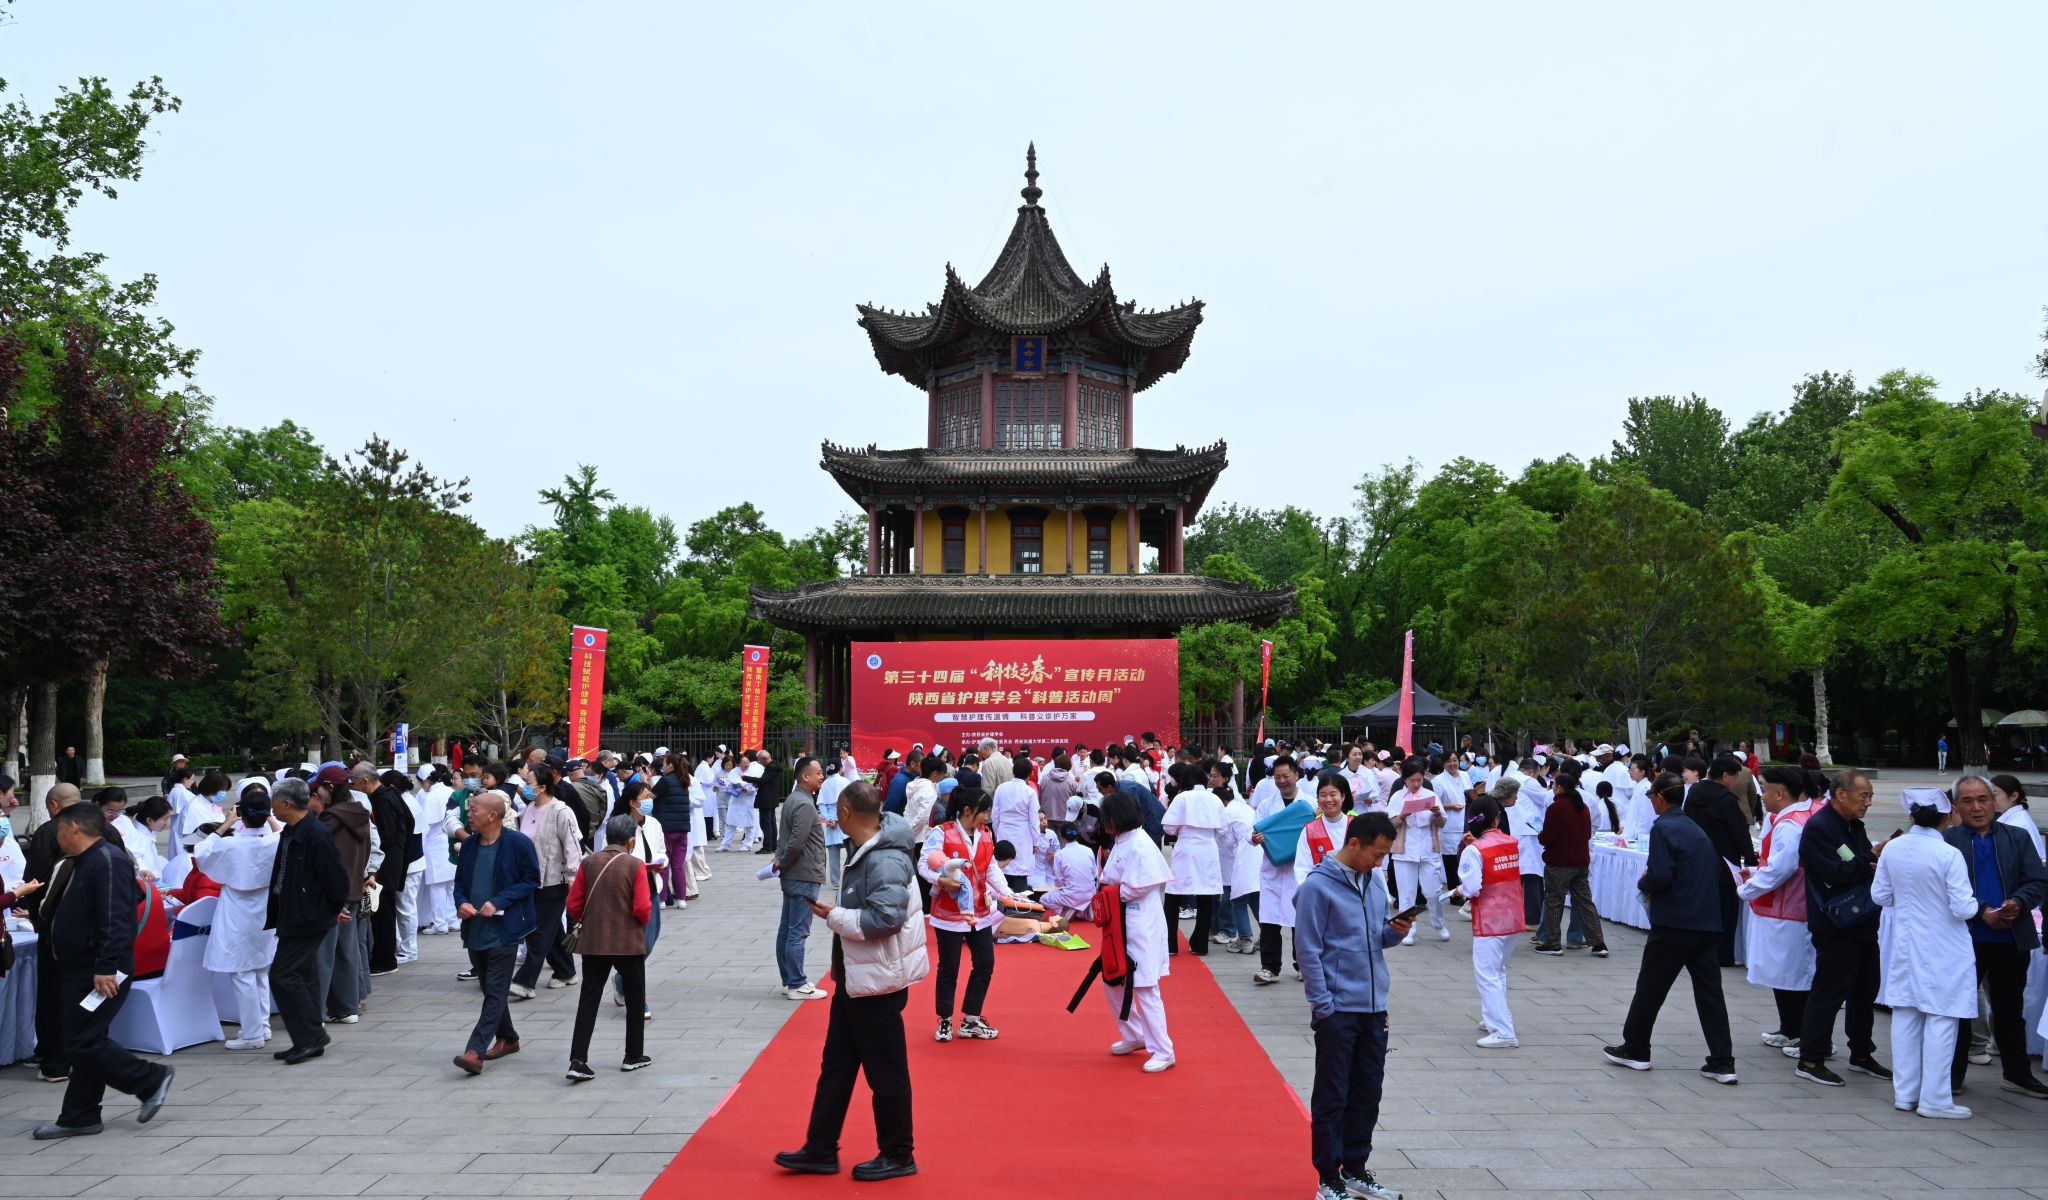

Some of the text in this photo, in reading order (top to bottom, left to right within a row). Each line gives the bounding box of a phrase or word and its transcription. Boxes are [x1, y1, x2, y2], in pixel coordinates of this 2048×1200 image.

[907, 688, 1122, 706] 陕西省护理学会“科普活动周”
[952, 712, 1078, 721] 智慧护理传温情 科普义诊护万家
